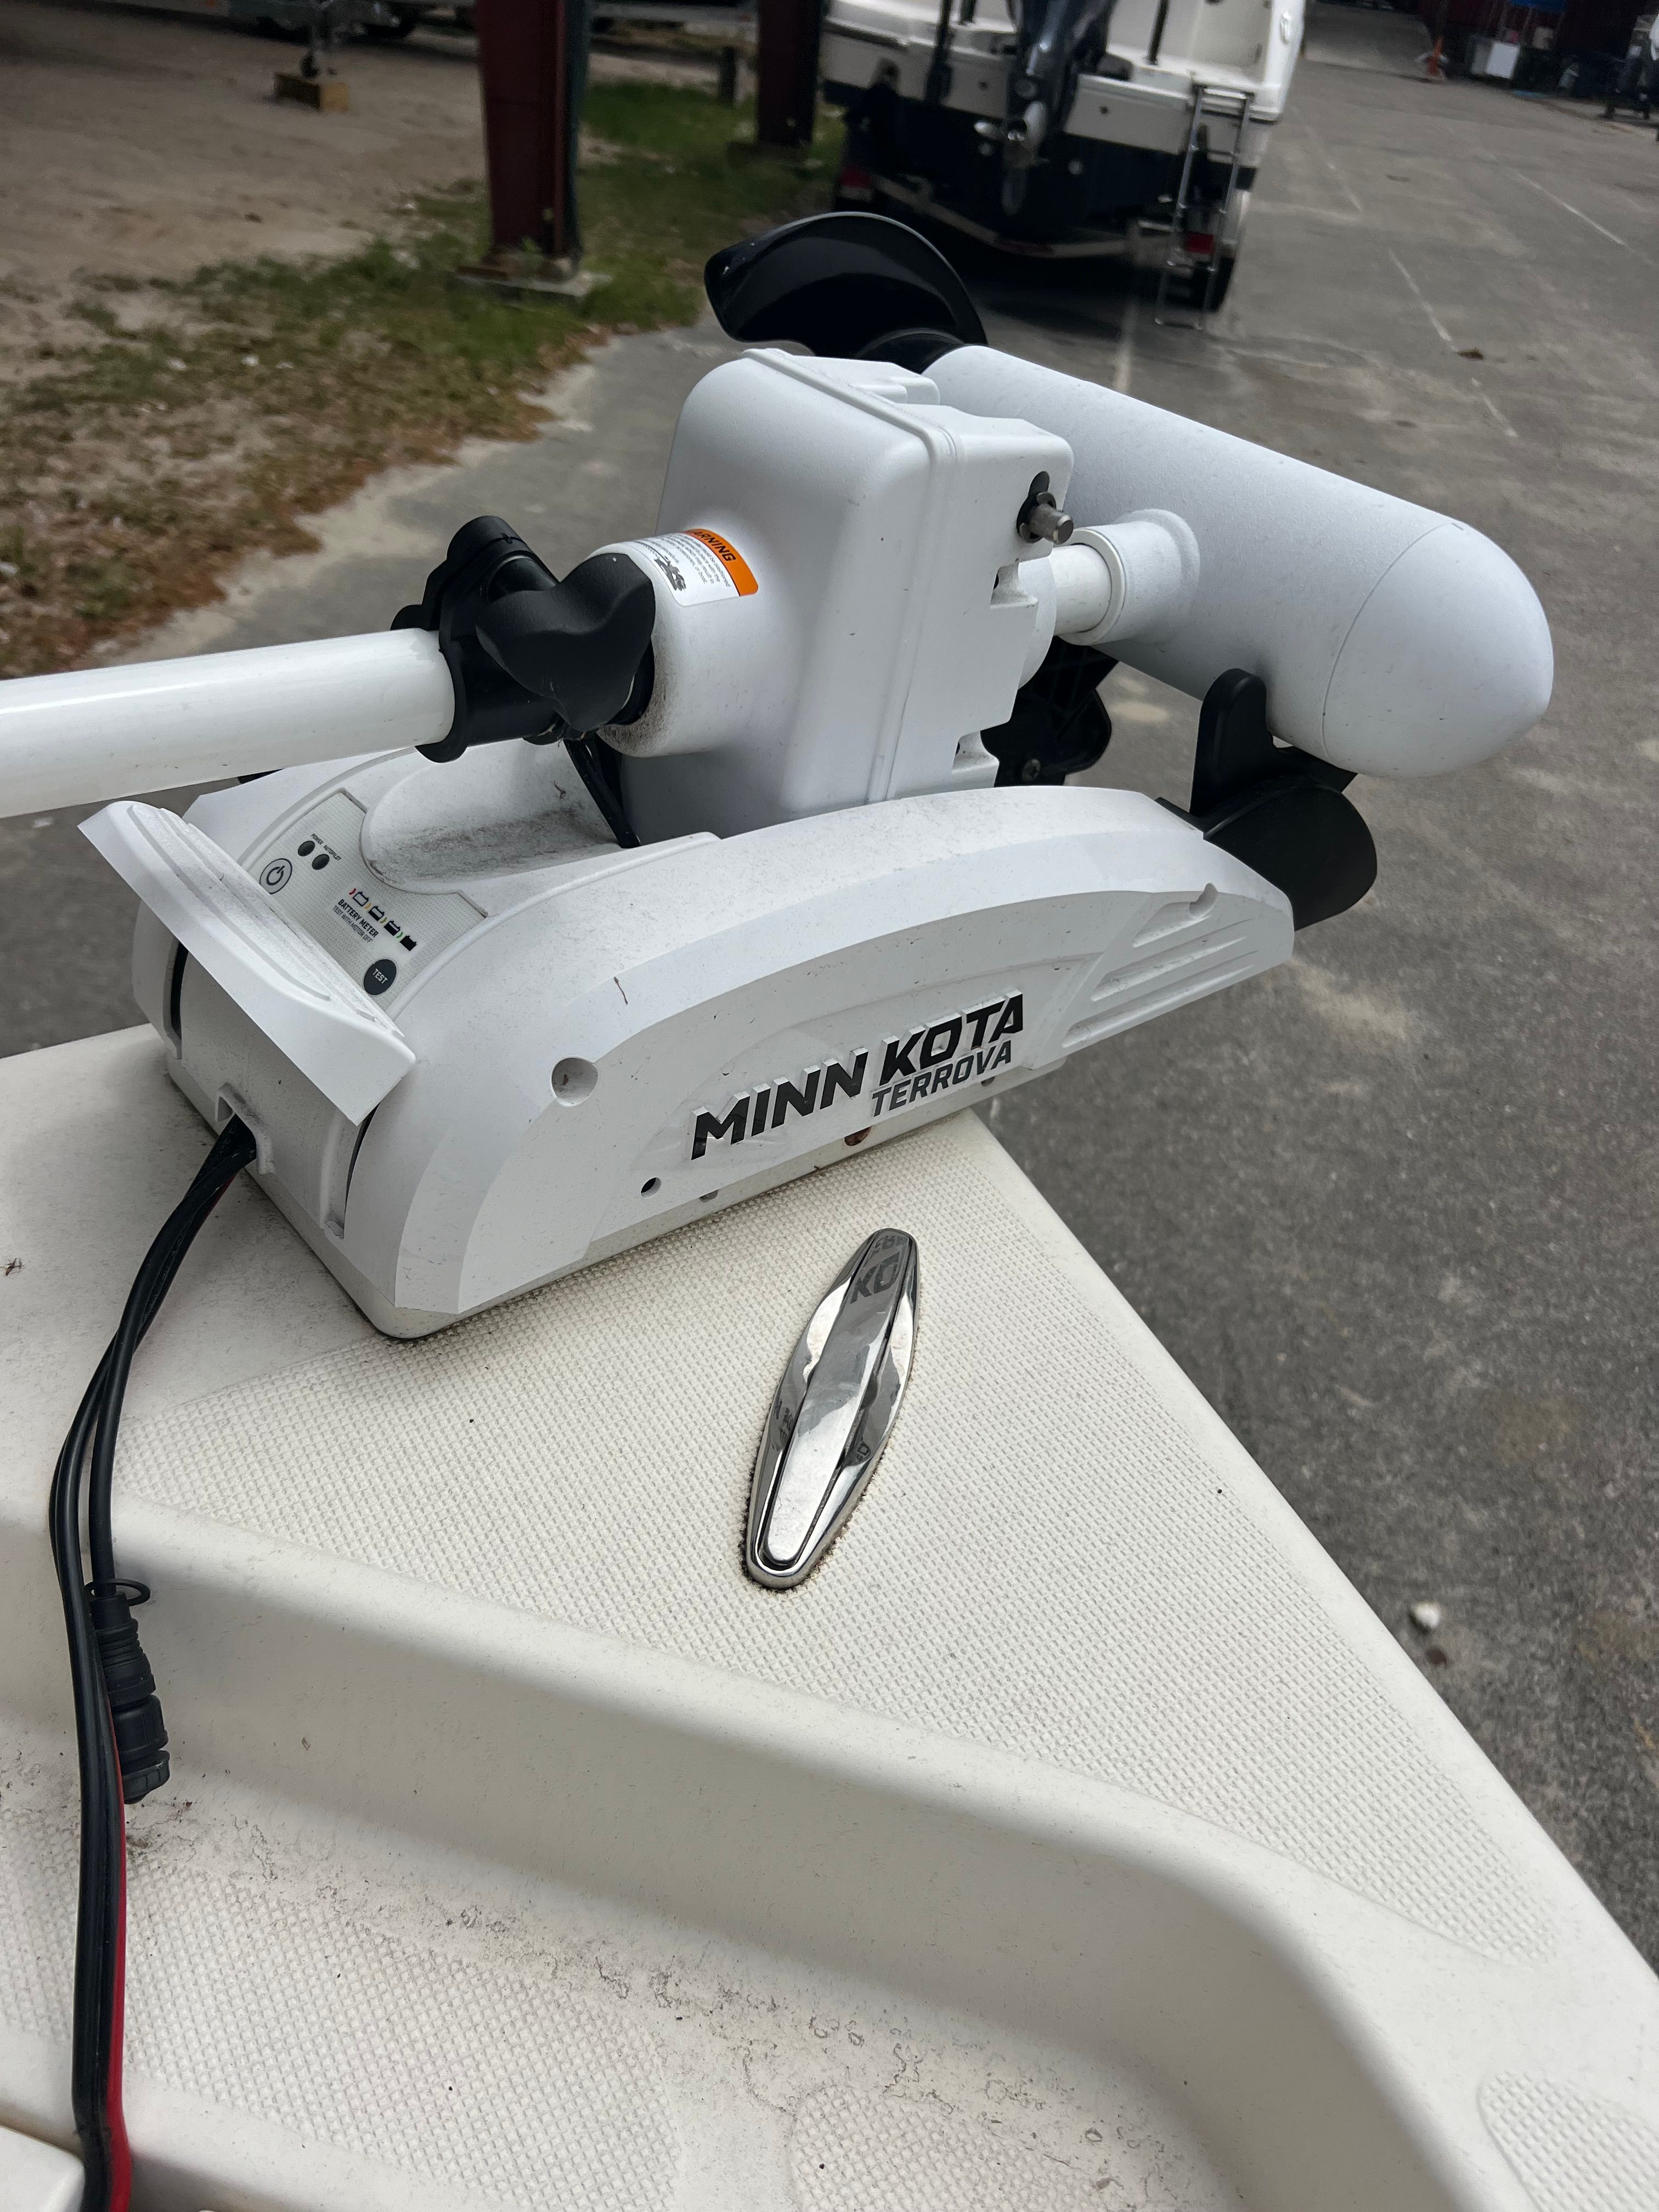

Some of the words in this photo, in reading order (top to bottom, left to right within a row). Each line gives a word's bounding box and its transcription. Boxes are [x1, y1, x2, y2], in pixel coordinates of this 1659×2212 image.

[690, 531, 736, 562] ARNING
[311, 833, 324, 845] POWER
[323, 845, 342, 861] AUTOPILOT
[332, 905, 343, 916] TEST
[341, 913, 352, 925] WITH
[351, 922, 365, 937] MOTOR
[363, 934, 373, 943] OFF
[338, 899, 362, 921] BATTERY
[359, 919, 379, 938] METER
[373, 968, 388, 984] TEST
[691, 1047, 869, 1161] MINN
[879, 992, 1024, 1087] KOTA
[871, 1040, 1011, 1118] TERROVA
